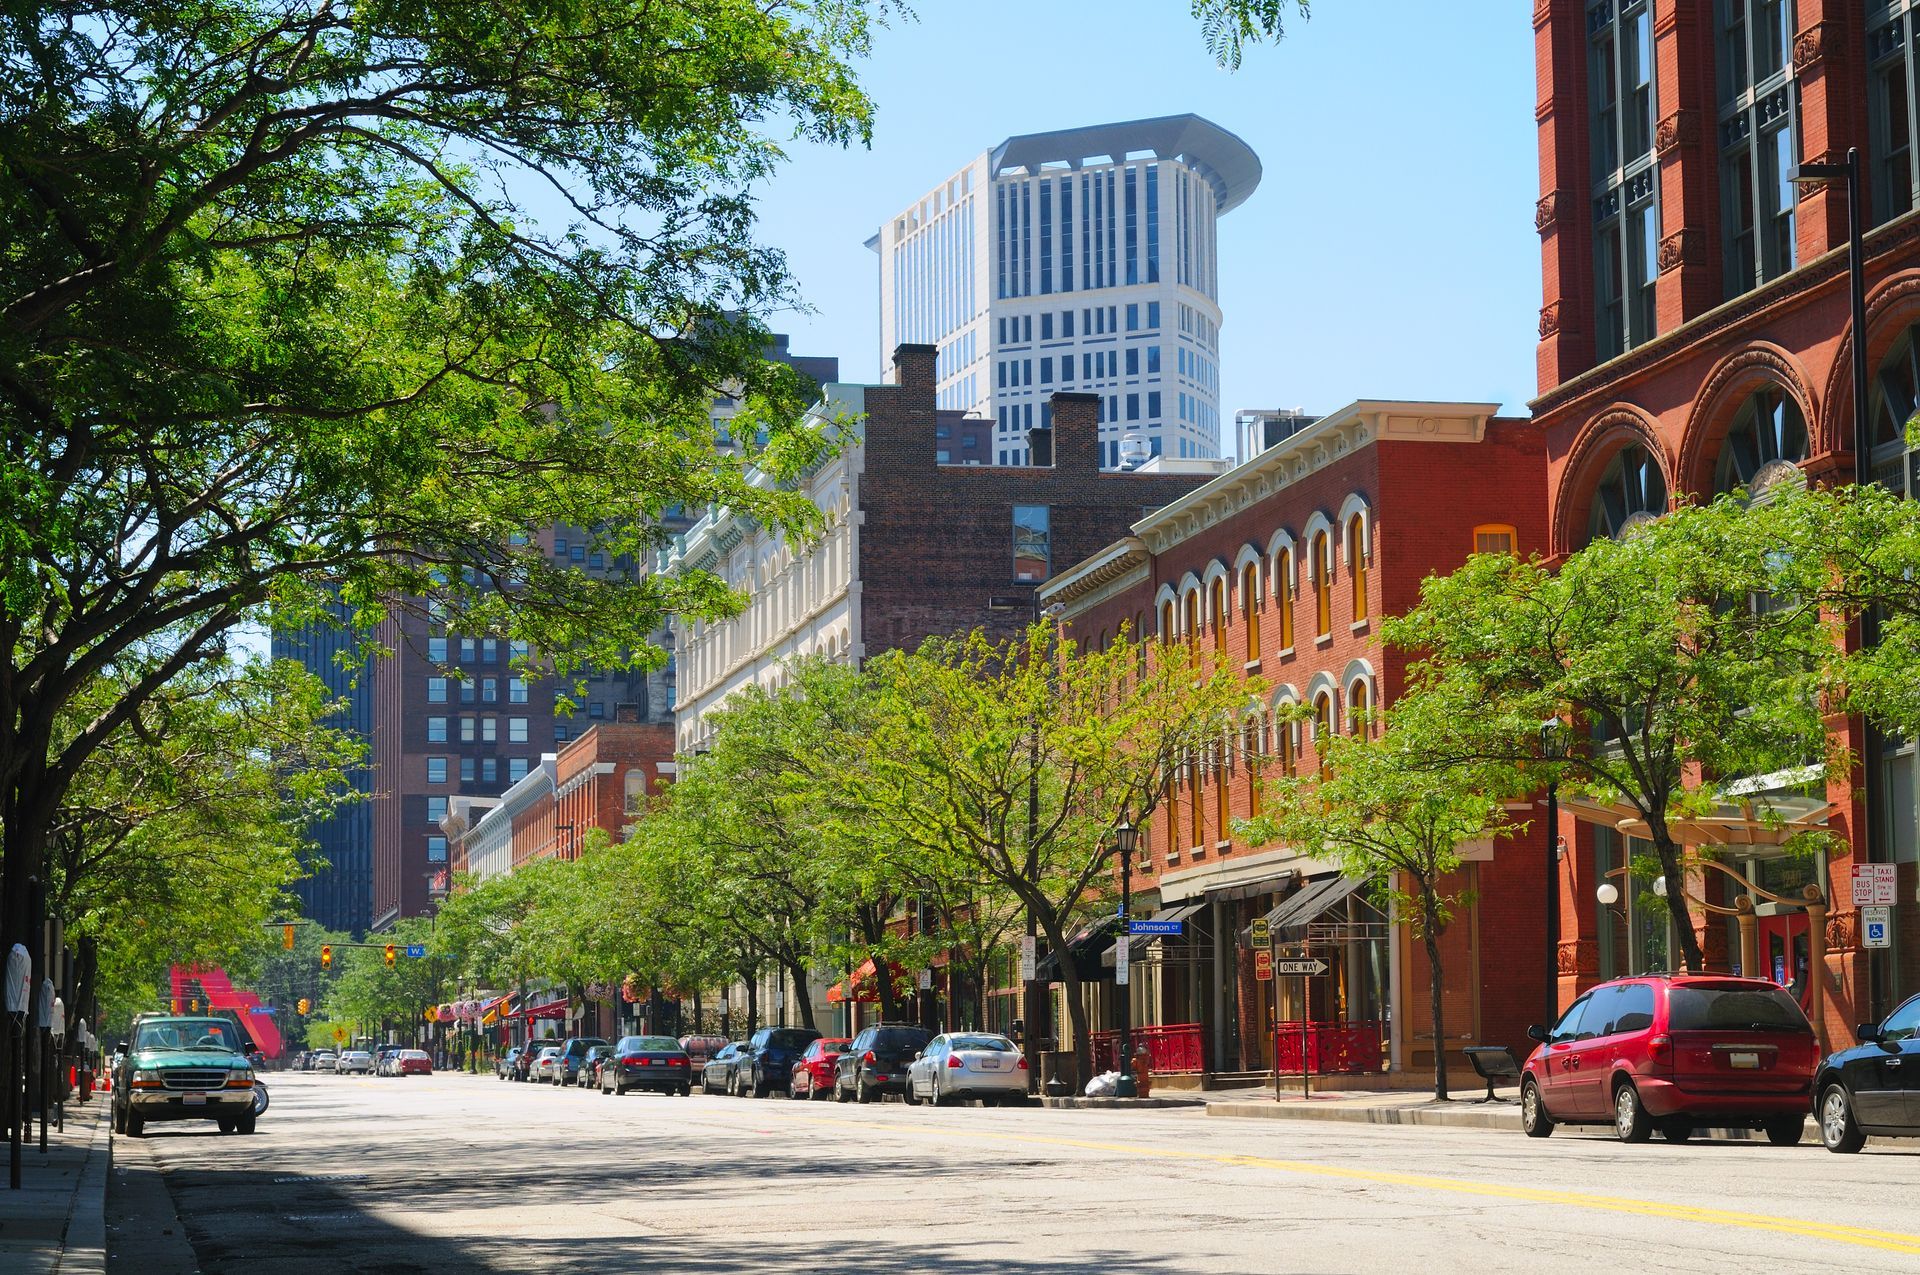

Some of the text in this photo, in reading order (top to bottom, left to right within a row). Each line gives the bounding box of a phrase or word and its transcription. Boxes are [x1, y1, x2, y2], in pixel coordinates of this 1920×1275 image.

[1132, 922, 1170, 932] Johnson
[411, 948, 423, 956] W.
[1282, 962, 1299, 972] ONE
[1301, 962, 1318, 972] WAY
